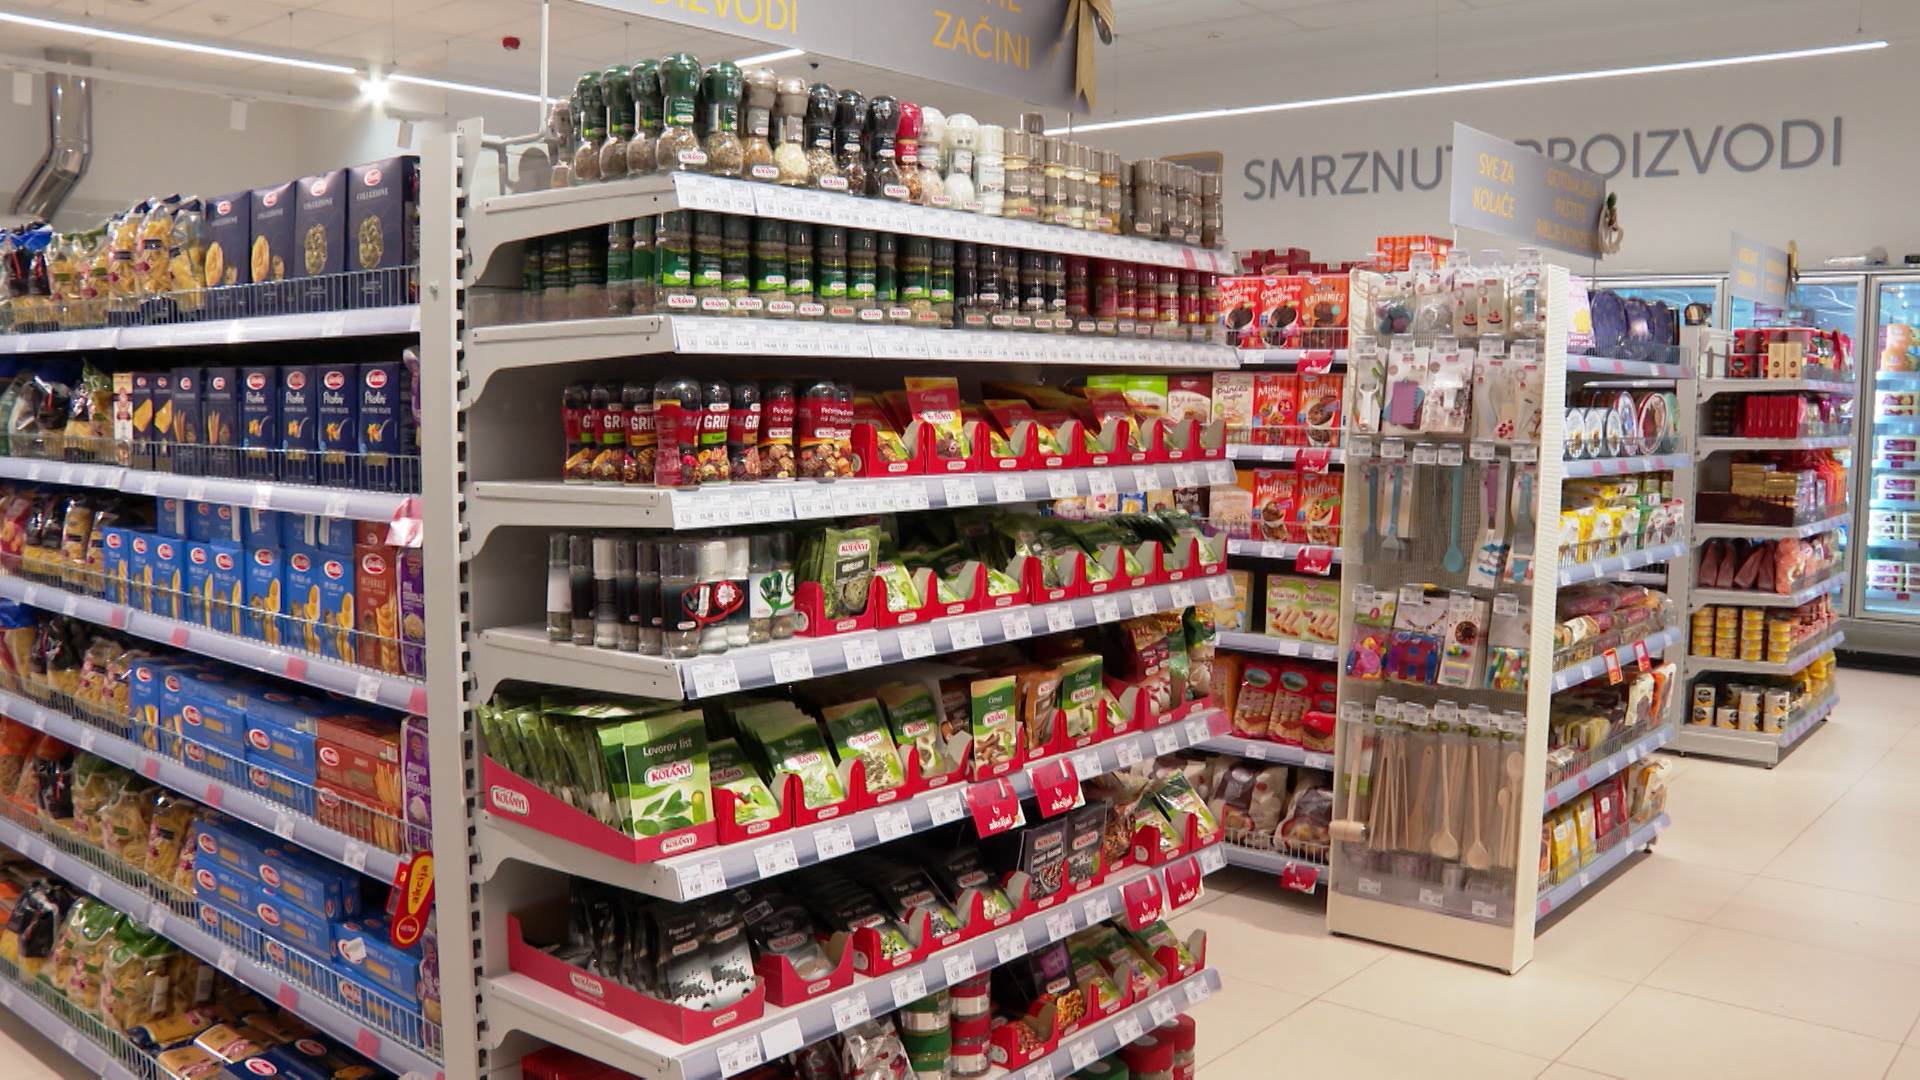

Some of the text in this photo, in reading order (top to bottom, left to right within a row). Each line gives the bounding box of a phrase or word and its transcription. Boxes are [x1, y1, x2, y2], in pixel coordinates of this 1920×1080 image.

[932, 9, 1030, 70] ZAČINI
[1243, 145, 1453, 201] SMRZNU
[1478, 152, 1515, 185] SVE ZA
[1472, 186, 1516, 219] KOLAČE
[643, 737, 693, 757] Lovorov list
[651, 763, 691, 783] KOTÁNYI
[495, 791, 526, 811] KOTÁNYI
[665, 834, 693, 850] KOTÁNYI
